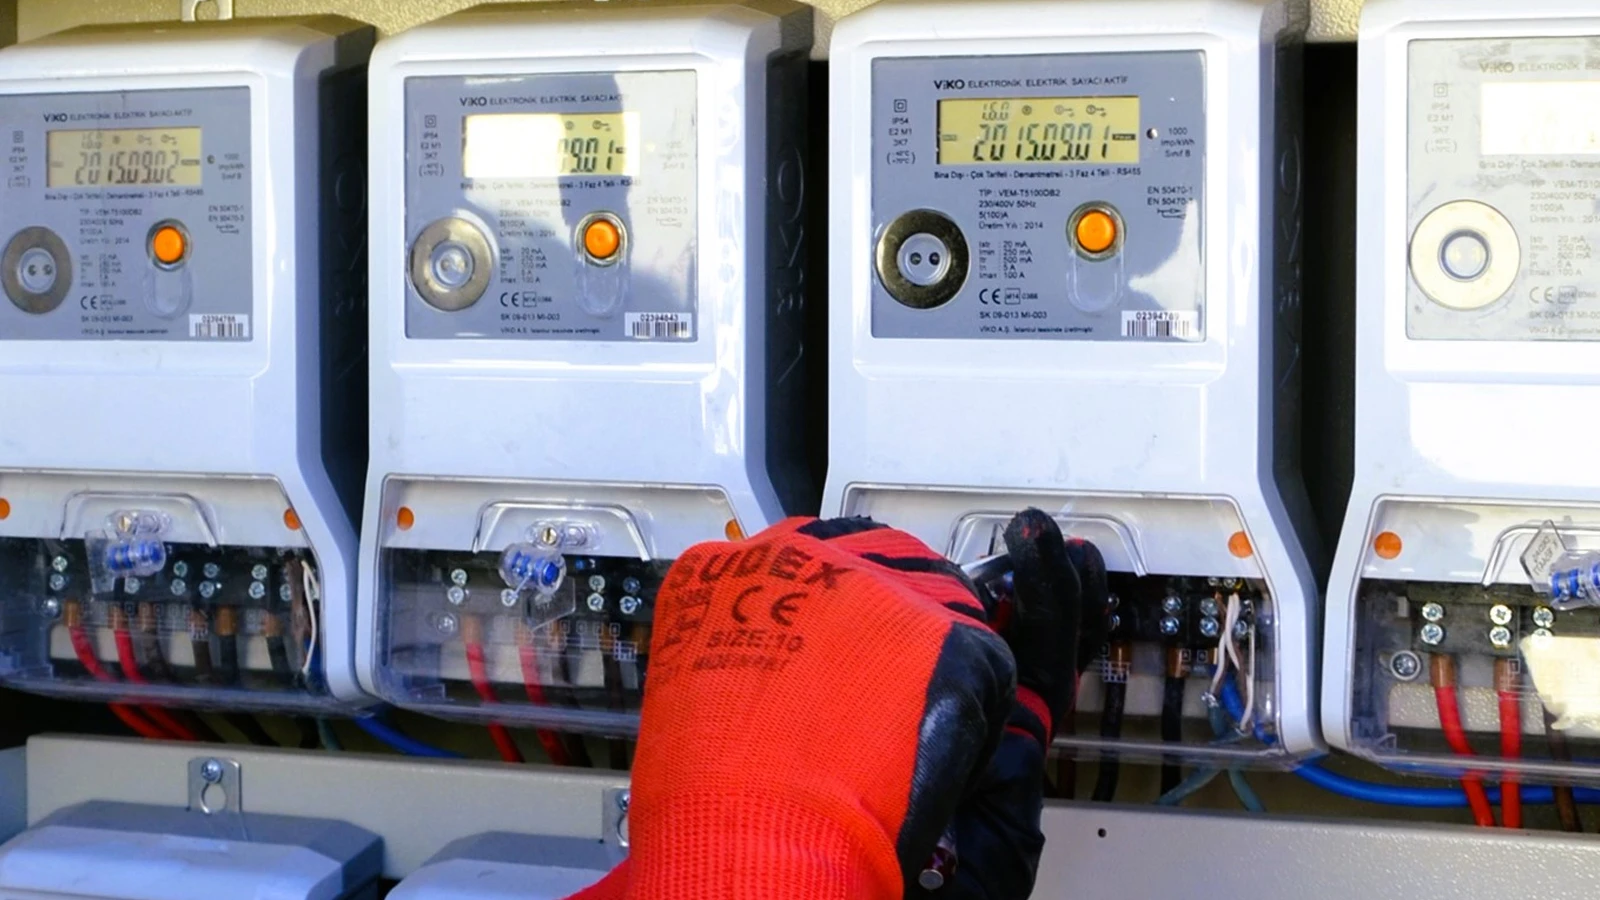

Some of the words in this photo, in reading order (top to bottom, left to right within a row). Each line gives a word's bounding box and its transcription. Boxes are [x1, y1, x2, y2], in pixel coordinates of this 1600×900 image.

[1168, 127, 1188, 136] 1000
[1146, 186, 1160, 194] EN
[1146, 197, 1160, 205] EN
[1024, 221, 1043, 230] 2014
[80, 295, 97, 310] CE
[500, 292, 519, 307] CE
[978, 288, 1001, 305] CE
[1529, 286, 1554, 304] CE
[731, 584, 809, 626] CE
